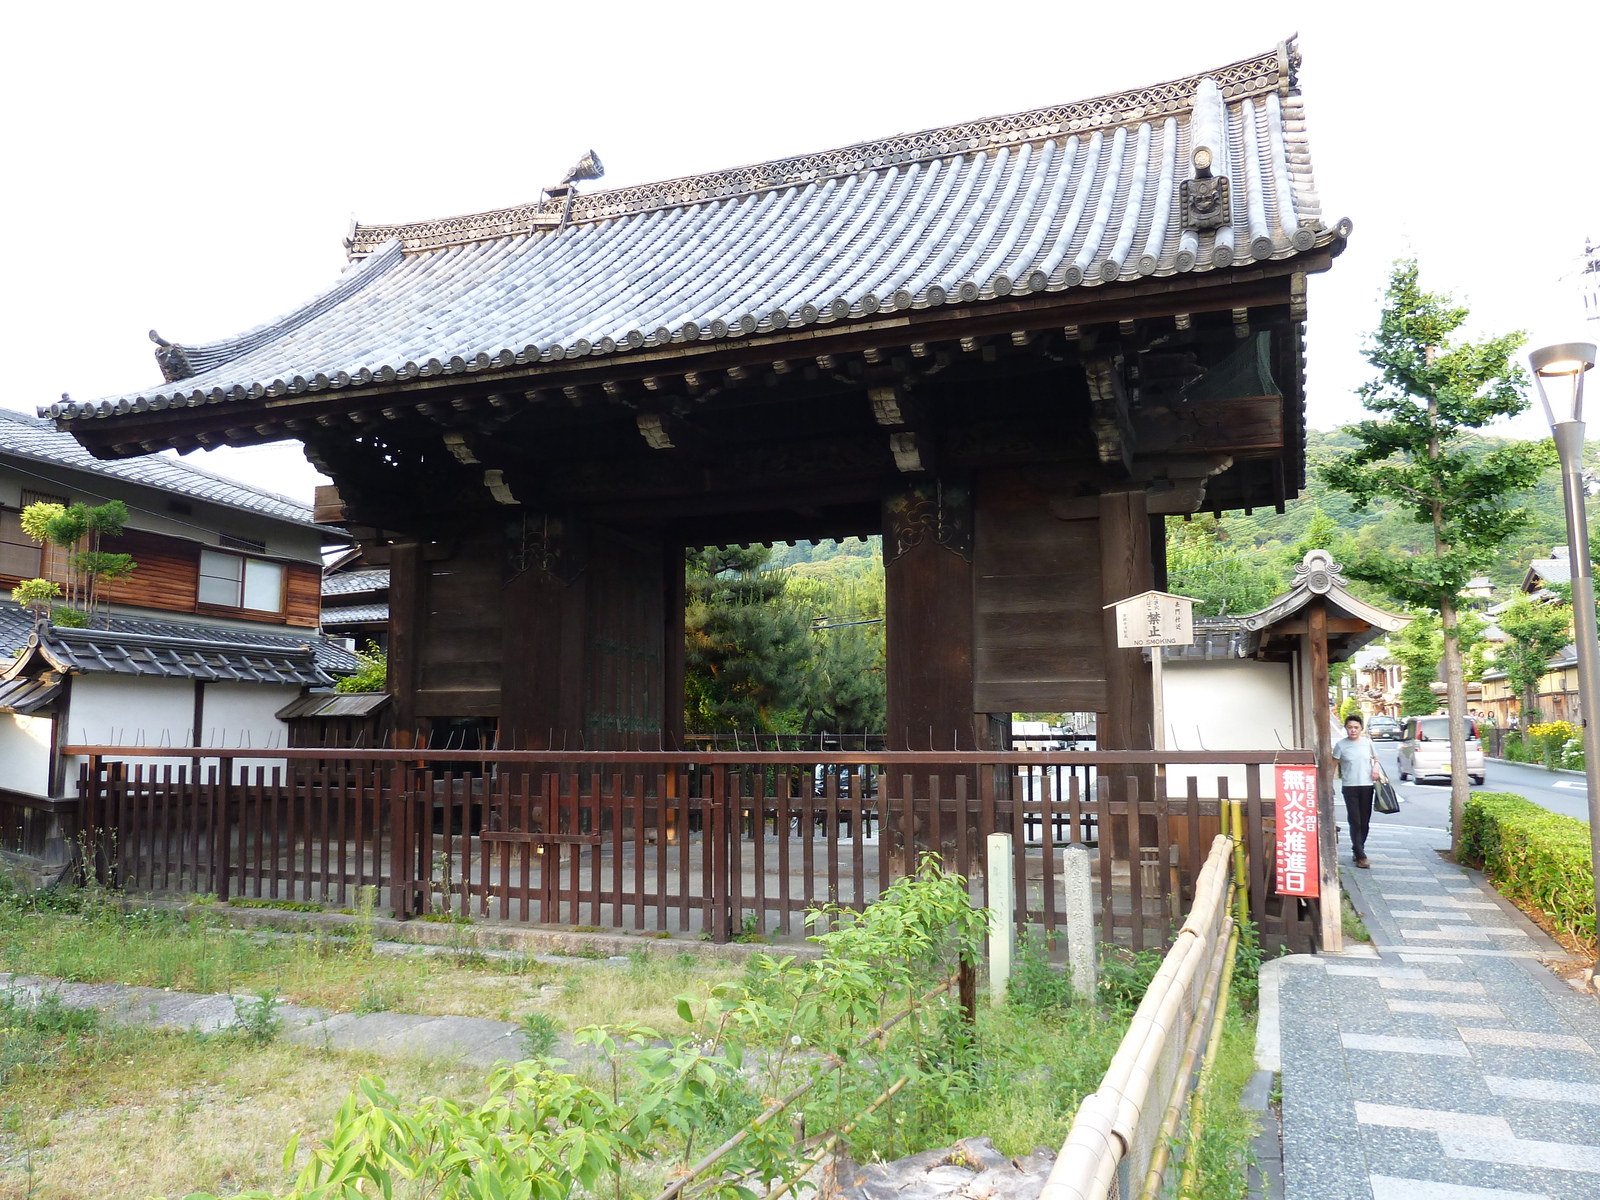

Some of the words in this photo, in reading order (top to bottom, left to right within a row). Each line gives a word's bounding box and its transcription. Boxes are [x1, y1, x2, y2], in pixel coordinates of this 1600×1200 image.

[1146, 611, 1162, 638] 禁止
[1282, 769, 1307, 892] 無火災推進日
